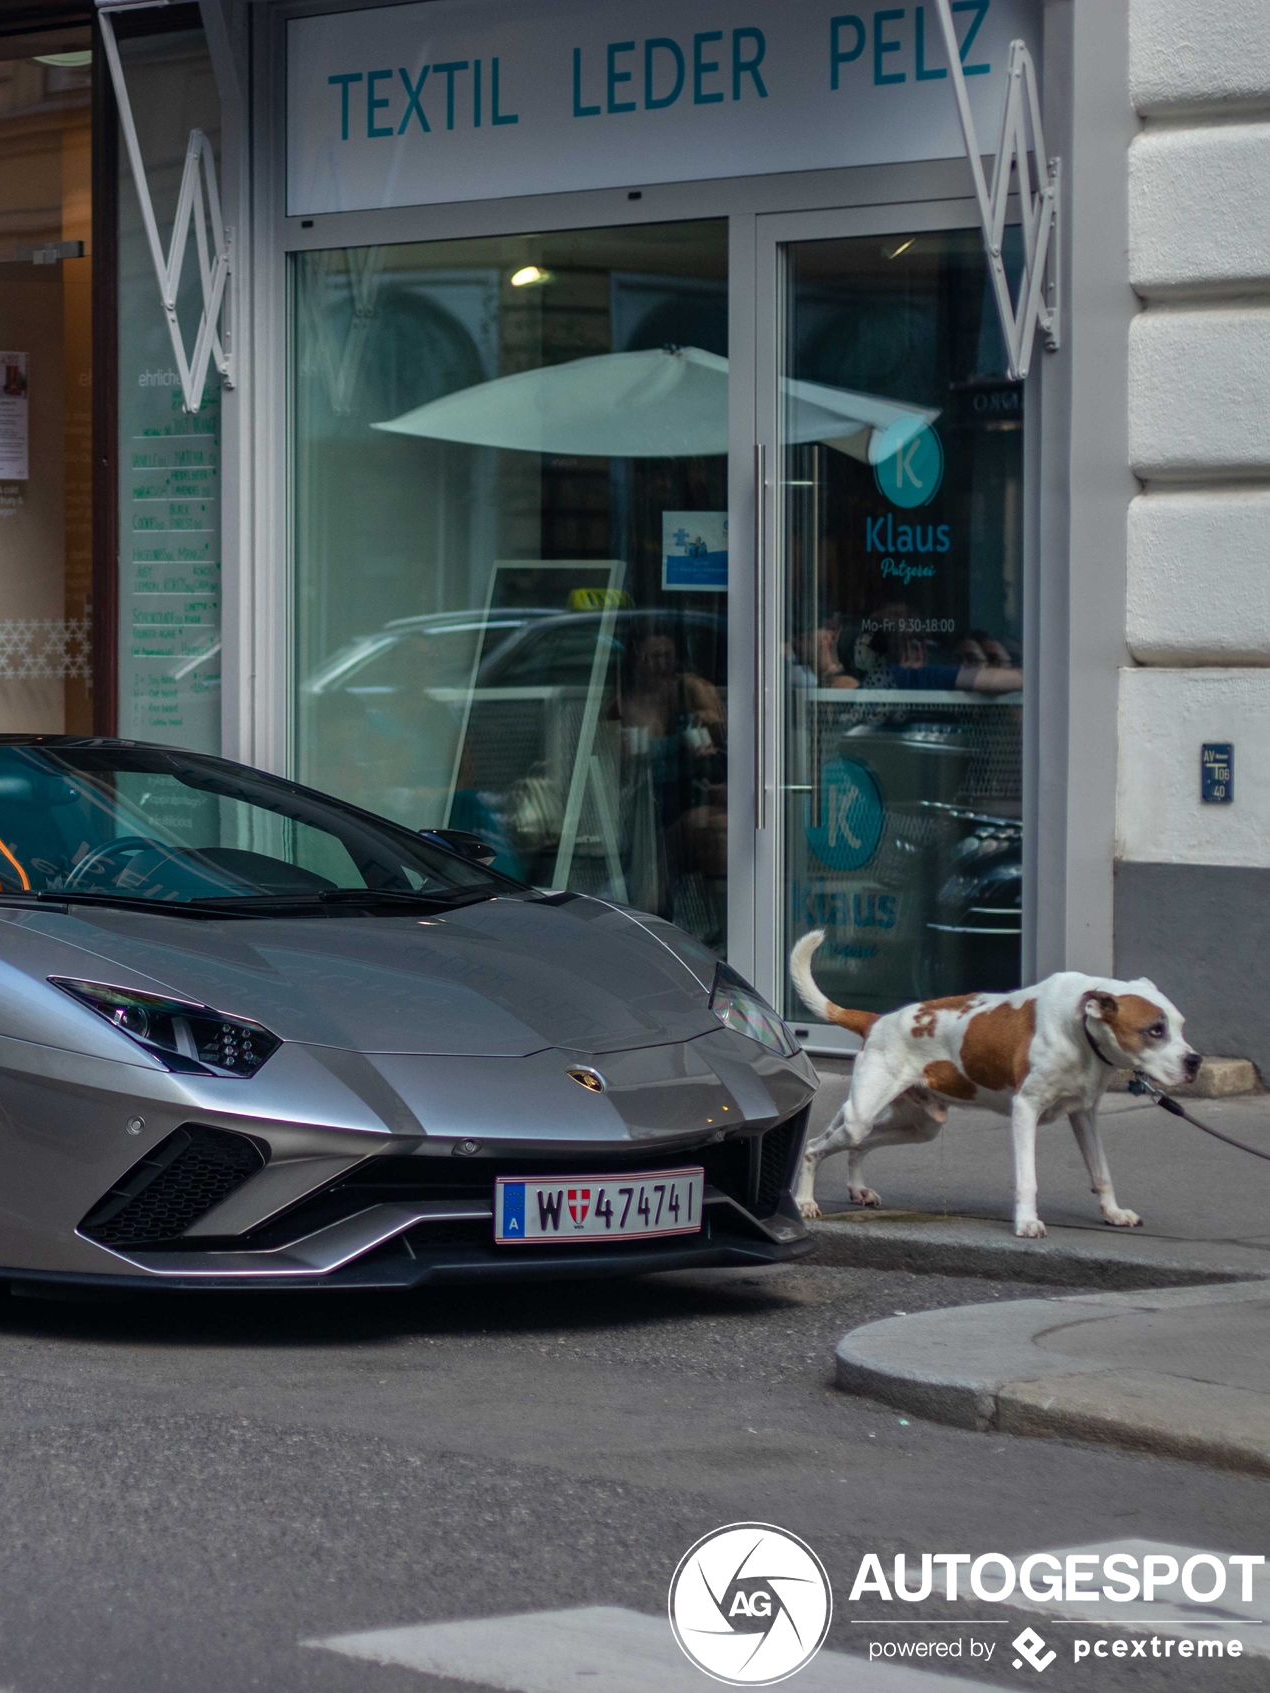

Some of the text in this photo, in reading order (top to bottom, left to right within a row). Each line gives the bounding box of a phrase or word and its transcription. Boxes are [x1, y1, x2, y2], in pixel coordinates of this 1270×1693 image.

[328, 0, 991, 141] TEXTIL LEDER PELZ
[866, 512, 951, 553] Klaus
[880, 557, 936, 585] Putzerei
[508, 1217, 520, 1231] A
[537, 1189, 564, 1231] W
